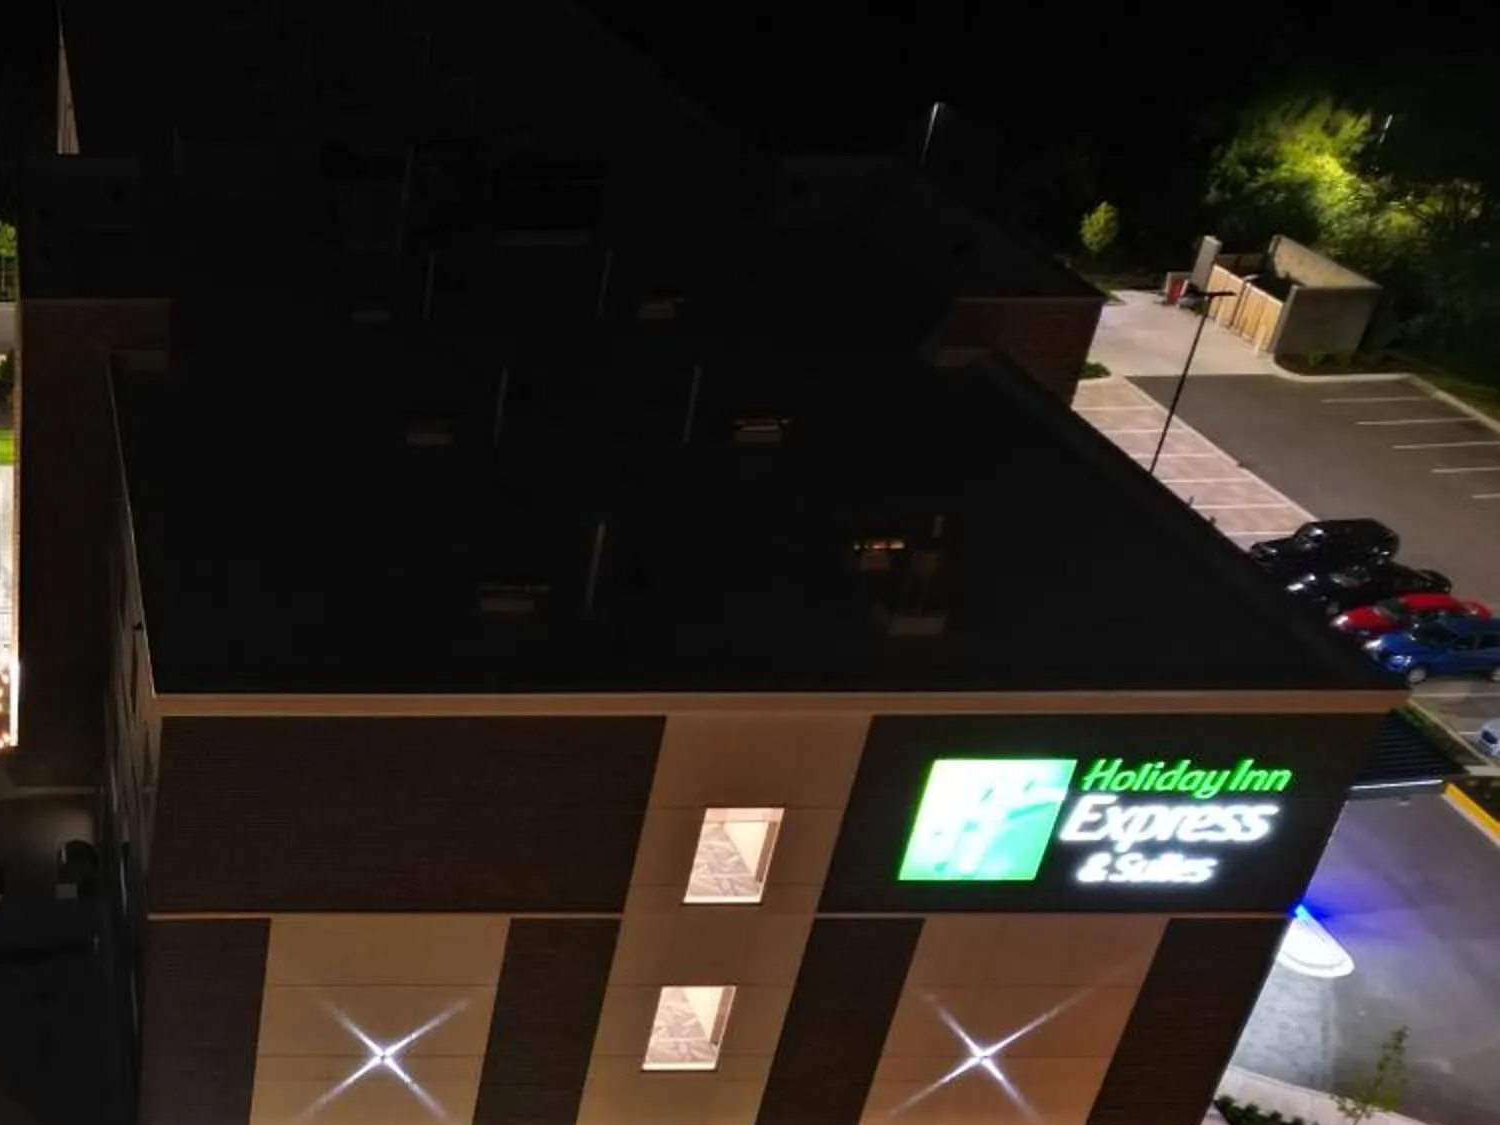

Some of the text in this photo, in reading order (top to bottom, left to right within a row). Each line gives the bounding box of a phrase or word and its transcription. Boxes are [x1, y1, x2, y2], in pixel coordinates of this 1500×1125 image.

[1082, 758, 1292, 799] Holiday Inn
[1059, 794, 1279, 852] Express
[1076, 852, 1218, 884] & Suites
